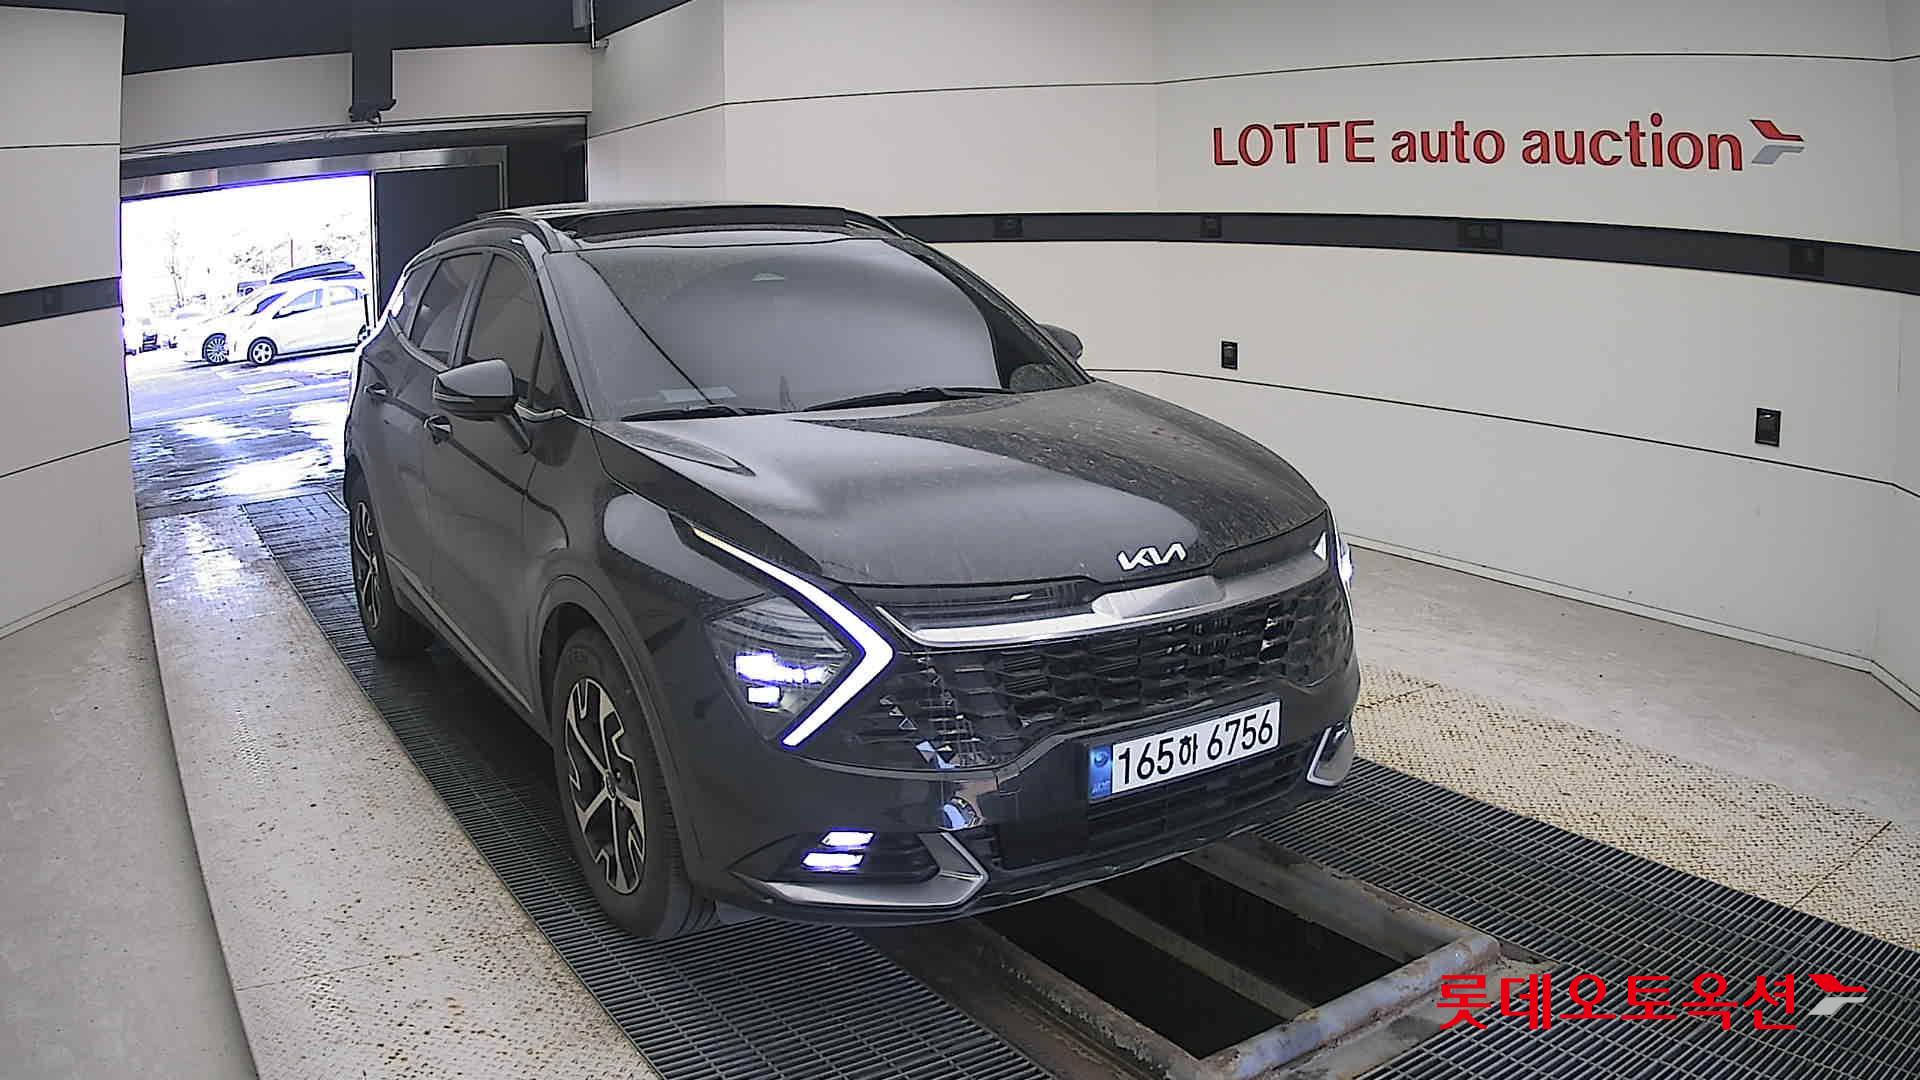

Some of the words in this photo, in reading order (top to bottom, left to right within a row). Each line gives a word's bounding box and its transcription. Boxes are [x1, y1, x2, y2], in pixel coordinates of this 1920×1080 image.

[1212, 119, 1375, 167] LOTTE
[1391, 120, 1506, 165] auto
[1521, 112, 1743, 171] auction
[1118, 732, 1199, 785] 165하
[1206, 708, 1273, 761] 6756
